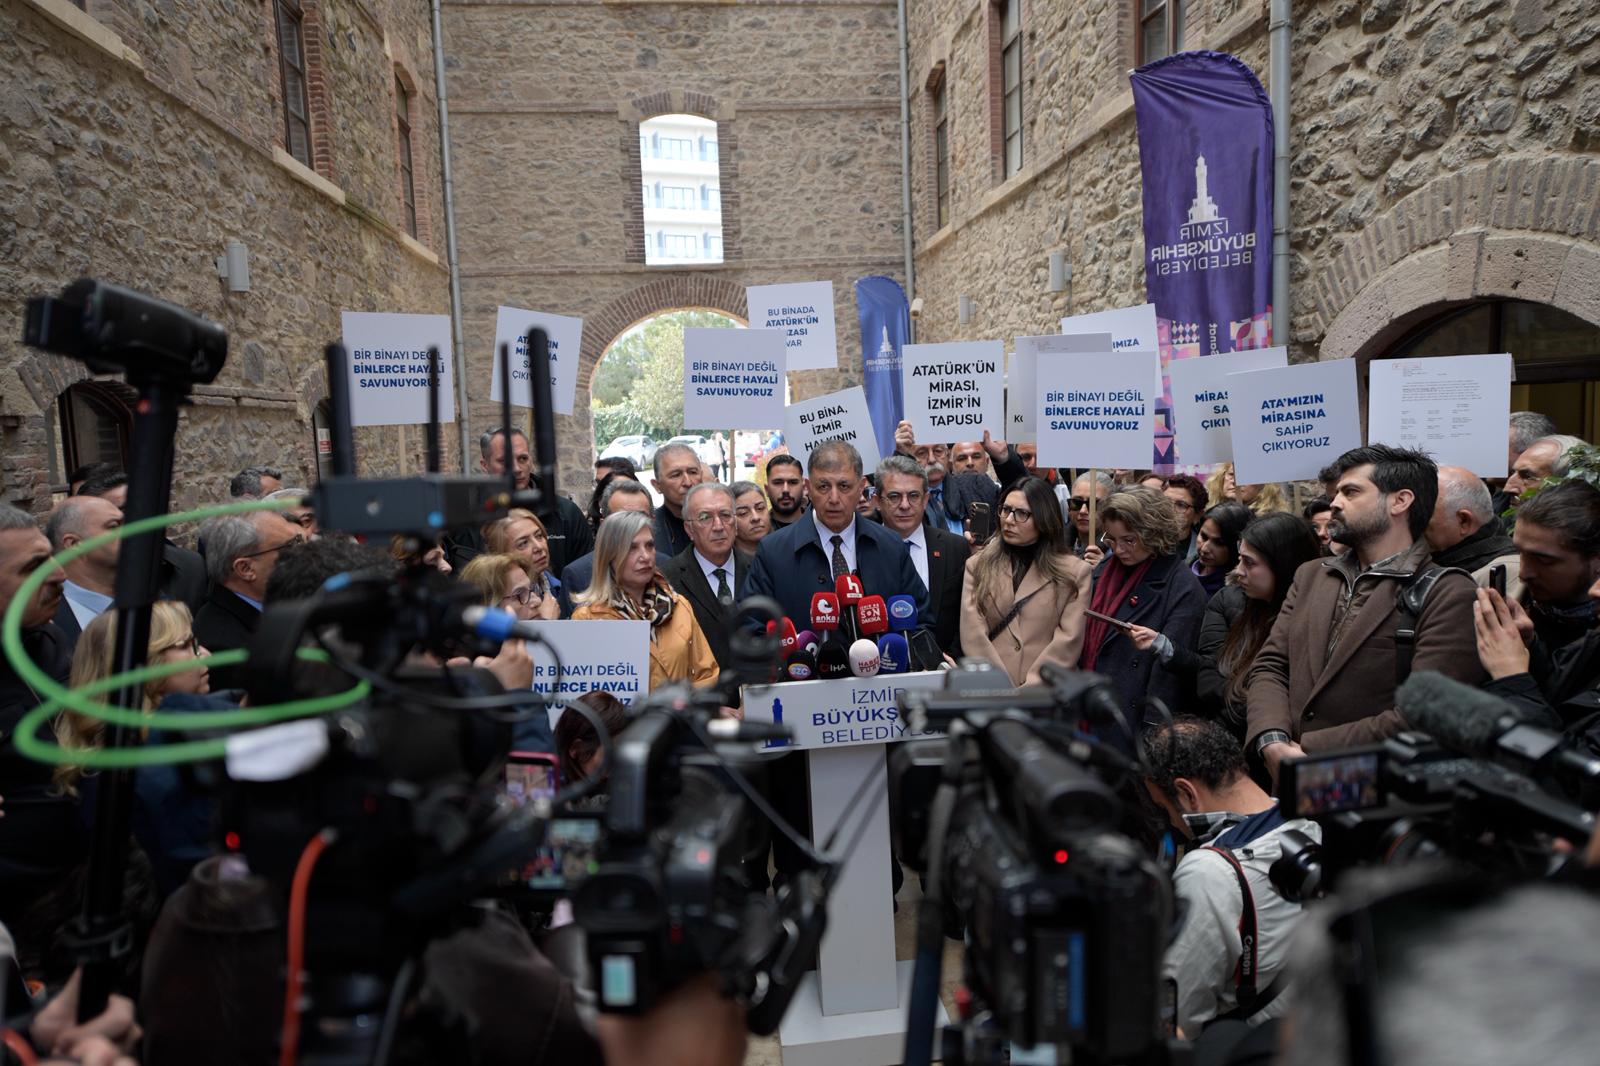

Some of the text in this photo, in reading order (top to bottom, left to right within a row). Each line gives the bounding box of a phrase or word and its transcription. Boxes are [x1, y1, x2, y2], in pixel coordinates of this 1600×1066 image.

[782, 306, 814, 315] BİNADA
[766, 316, 818, 327] ATATÜRK'ÜN
[354, 348, 371, 360] BİR
[375, 349, 409, 360] BİNAYI
[354, 362, 406, 373] BİNLERCE
[693, 360, 777, 371] BİR BİNAYI DEĞİL
[912, 360, 995, 376] ATATÜRK'ÜN
[692, 373, 778, 384] BİNLERCE HAYALİ
[930, 379, 979, 392] MİRASI,
[697, 388, 773, 396] SAVUNUYORUZ
[1047, 390, 1144, 402] BİR BİNAYI DEĞİL
[928, 395, 980, 409] İZMİR'İN
[1261, 394, 1324, 410] ATA'MIZIN
[800, 405, 848, 424] BU BİNA,
[1045, 404, 1144, 416] BİNLERCE HAYALİ
[1213, 404, 1229, 414] SA
[930, 414, 983, 426] TAPUSU
[1261, 408, 1326, 424] MİRASINA
[812, 419, 842, 435] İZMİR
[1051, 421, 1139, 430] SAVUNUYORUZ
[1276, 423, 1313, 436] SAHİP
[1262, 437, 1330, 454] ÇIKIYORUZ
[597, 663, 638, 675] DEĞİL
[534, 679, 638, 693] NLERCE HAYALİ
[813, 706, 898, 726] BÜYÜKŞ
[1242, 935, 1253, 976] Canon
